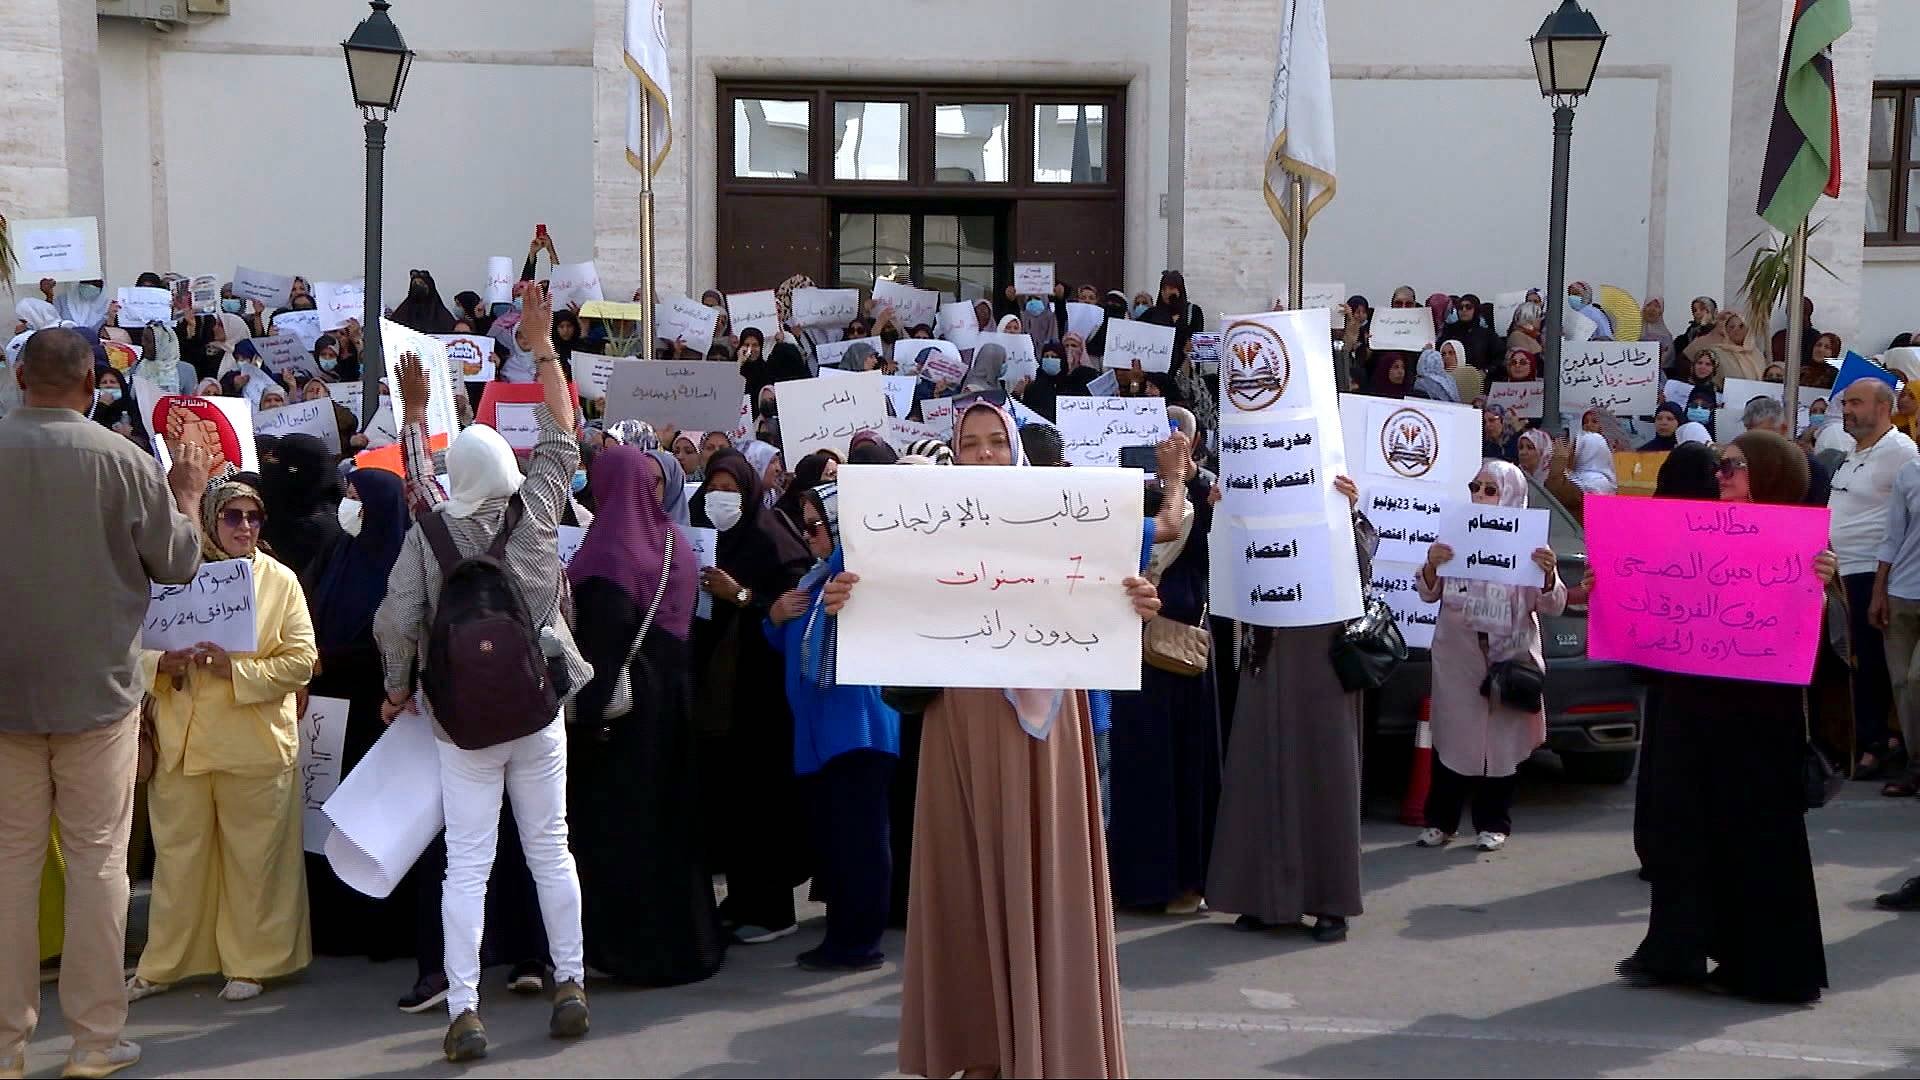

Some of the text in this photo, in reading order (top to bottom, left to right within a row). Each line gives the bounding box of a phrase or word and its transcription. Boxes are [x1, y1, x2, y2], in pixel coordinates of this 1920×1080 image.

[822, 391, 857, 412] المعلم
[1262, 433, 1312, 451] مدرسة
[1263, 469, 1315, 494] اعتصام
[999, 489, 1112, 527] نطالب
[1686, 506, 1759, 535] مطالبنا
[1378, 526, 1406, 540] اعتصا
[1468, 514, 1519, 533] اعتصام
[1245, 539, 1298, 563] اعتصام
[1466, 550, 1516, 570] اعتصام
[198, 563, 245, 594] اليوم
[936, 561, 1035, 591] سنوات
[1249, 583, 1302, 608] اعتصام
[196, 596, 250, 624] الموافق
[915, 608, 1099, 652] بدون راتب
